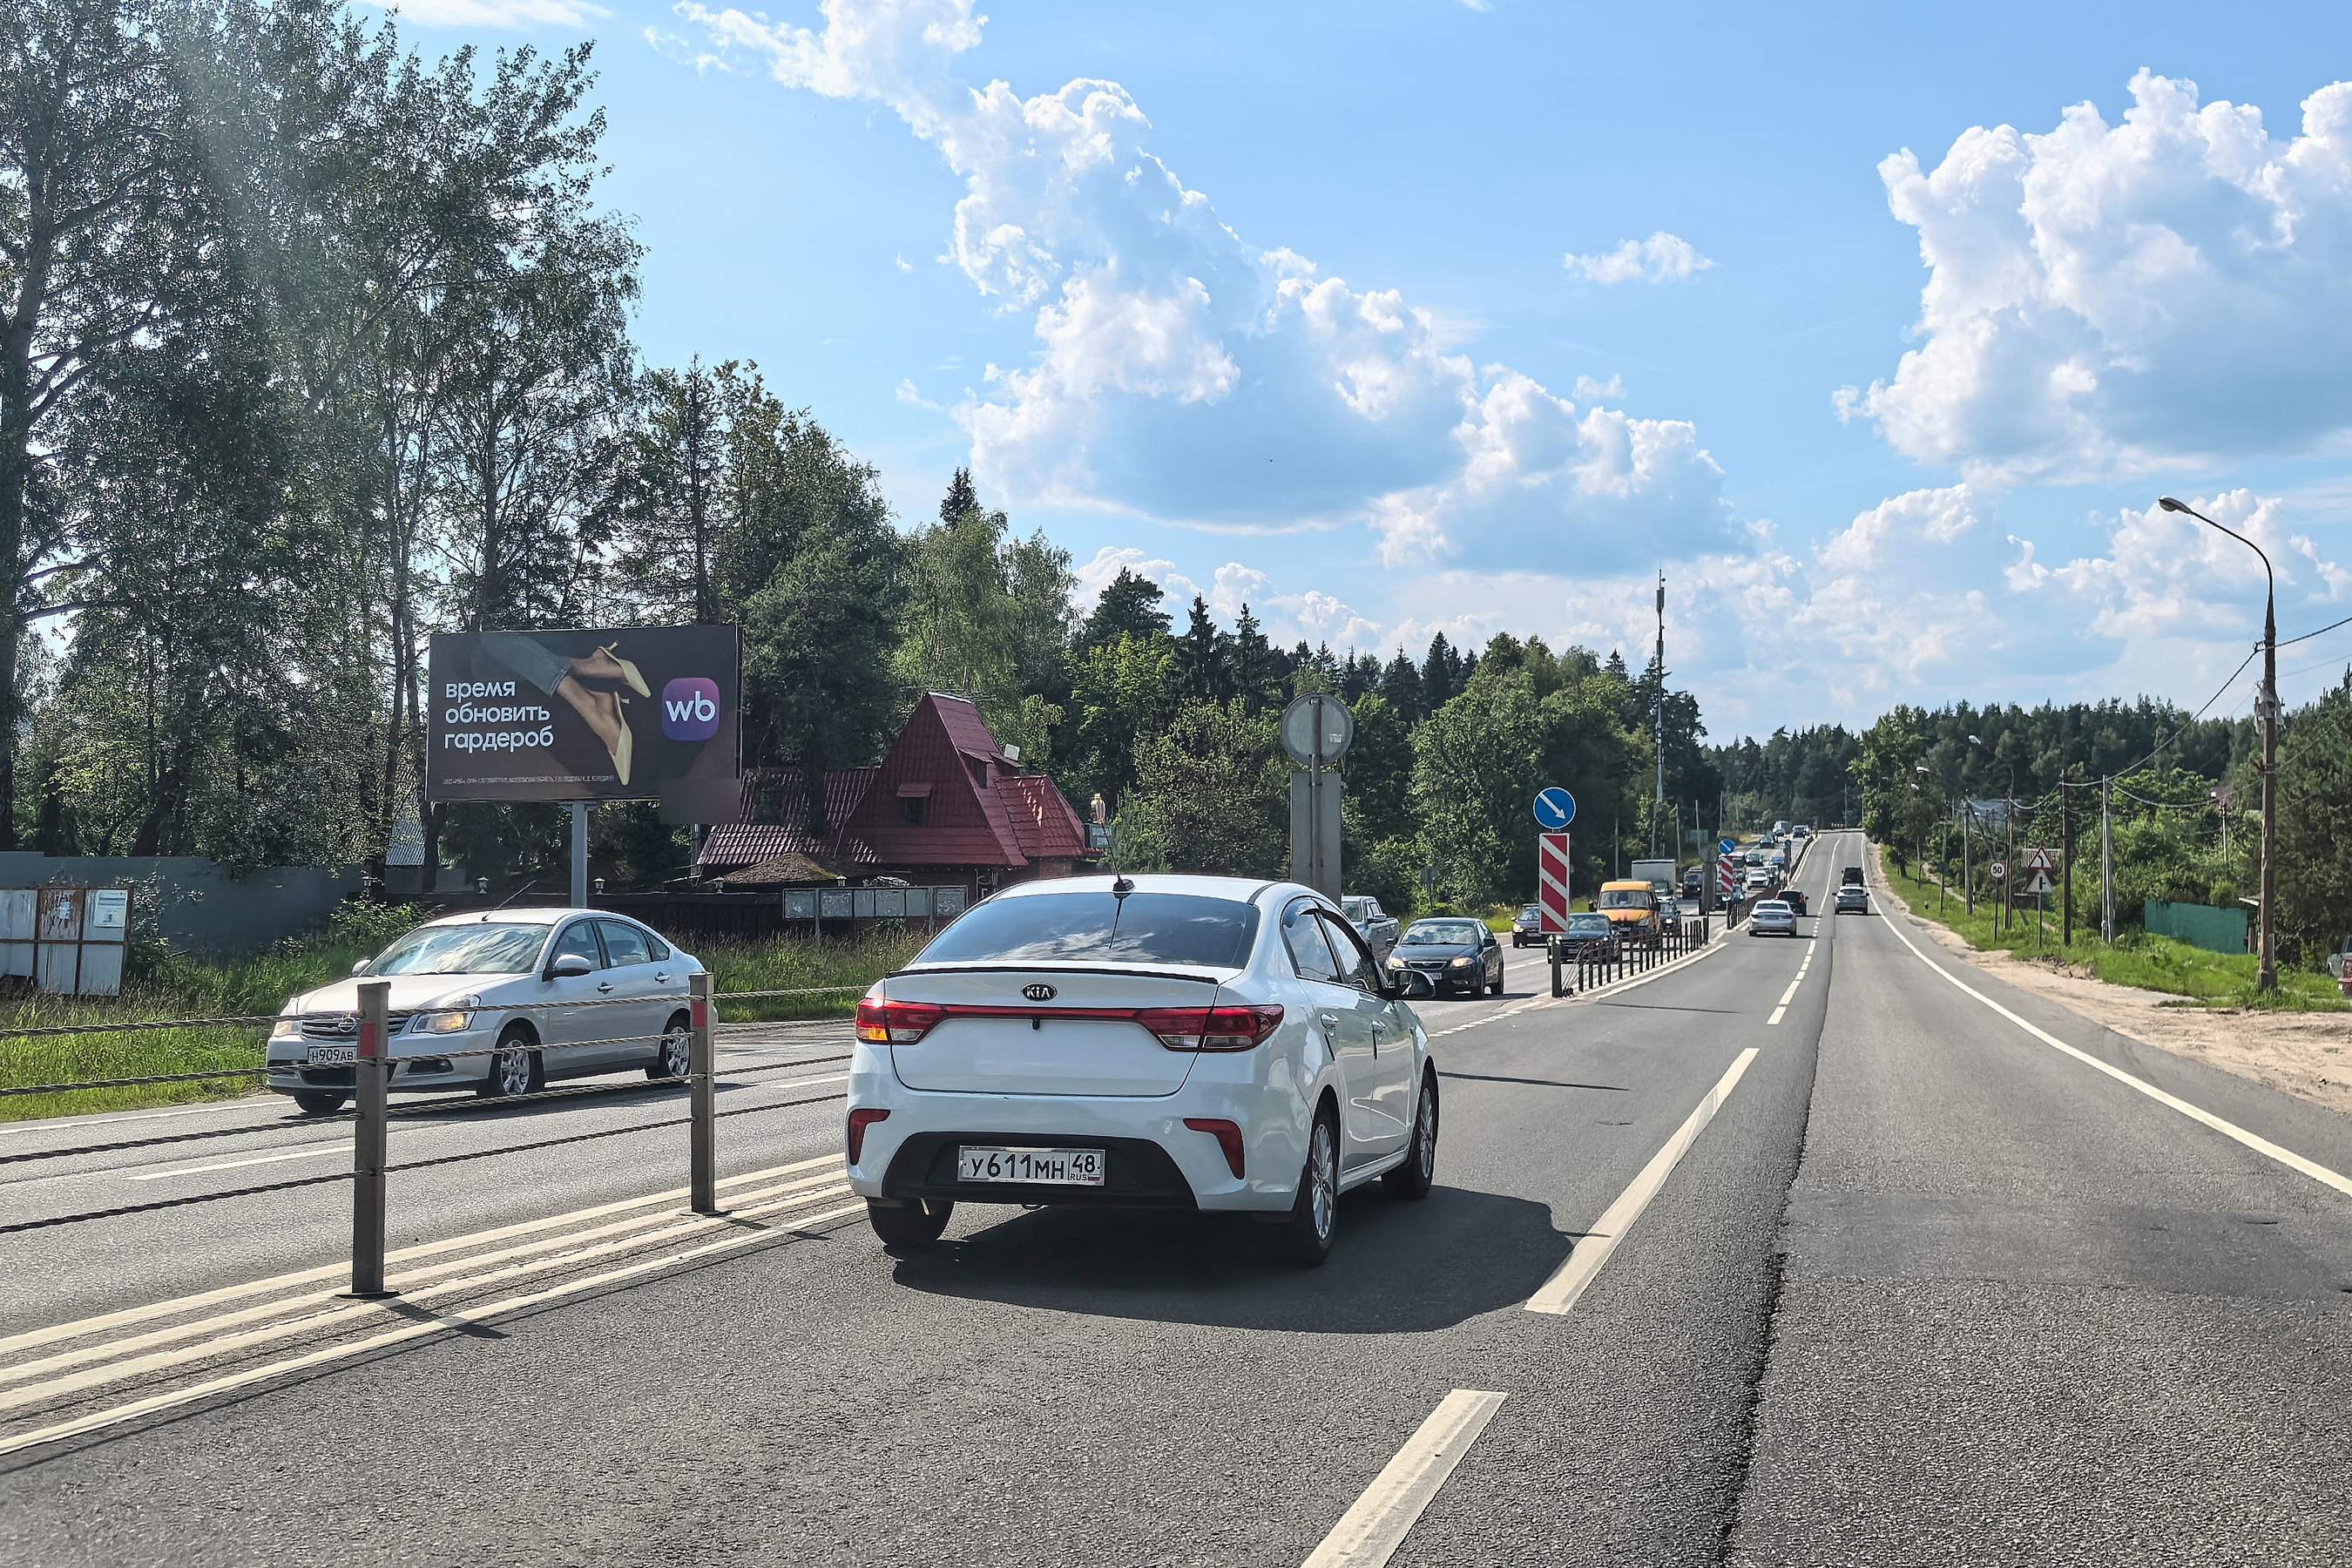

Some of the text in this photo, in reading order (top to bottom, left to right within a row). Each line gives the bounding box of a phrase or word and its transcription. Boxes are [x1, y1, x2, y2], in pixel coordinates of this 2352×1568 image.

[445, 681, 516, 703] время
[445, 702, 551, 724] обновить
[665, 691, 715, 722] wb
[444, 725, 554, 754] гардероб
[1026, 986, 1051, 997] KIA
[1071, 1154, 1095, 1173] 48
